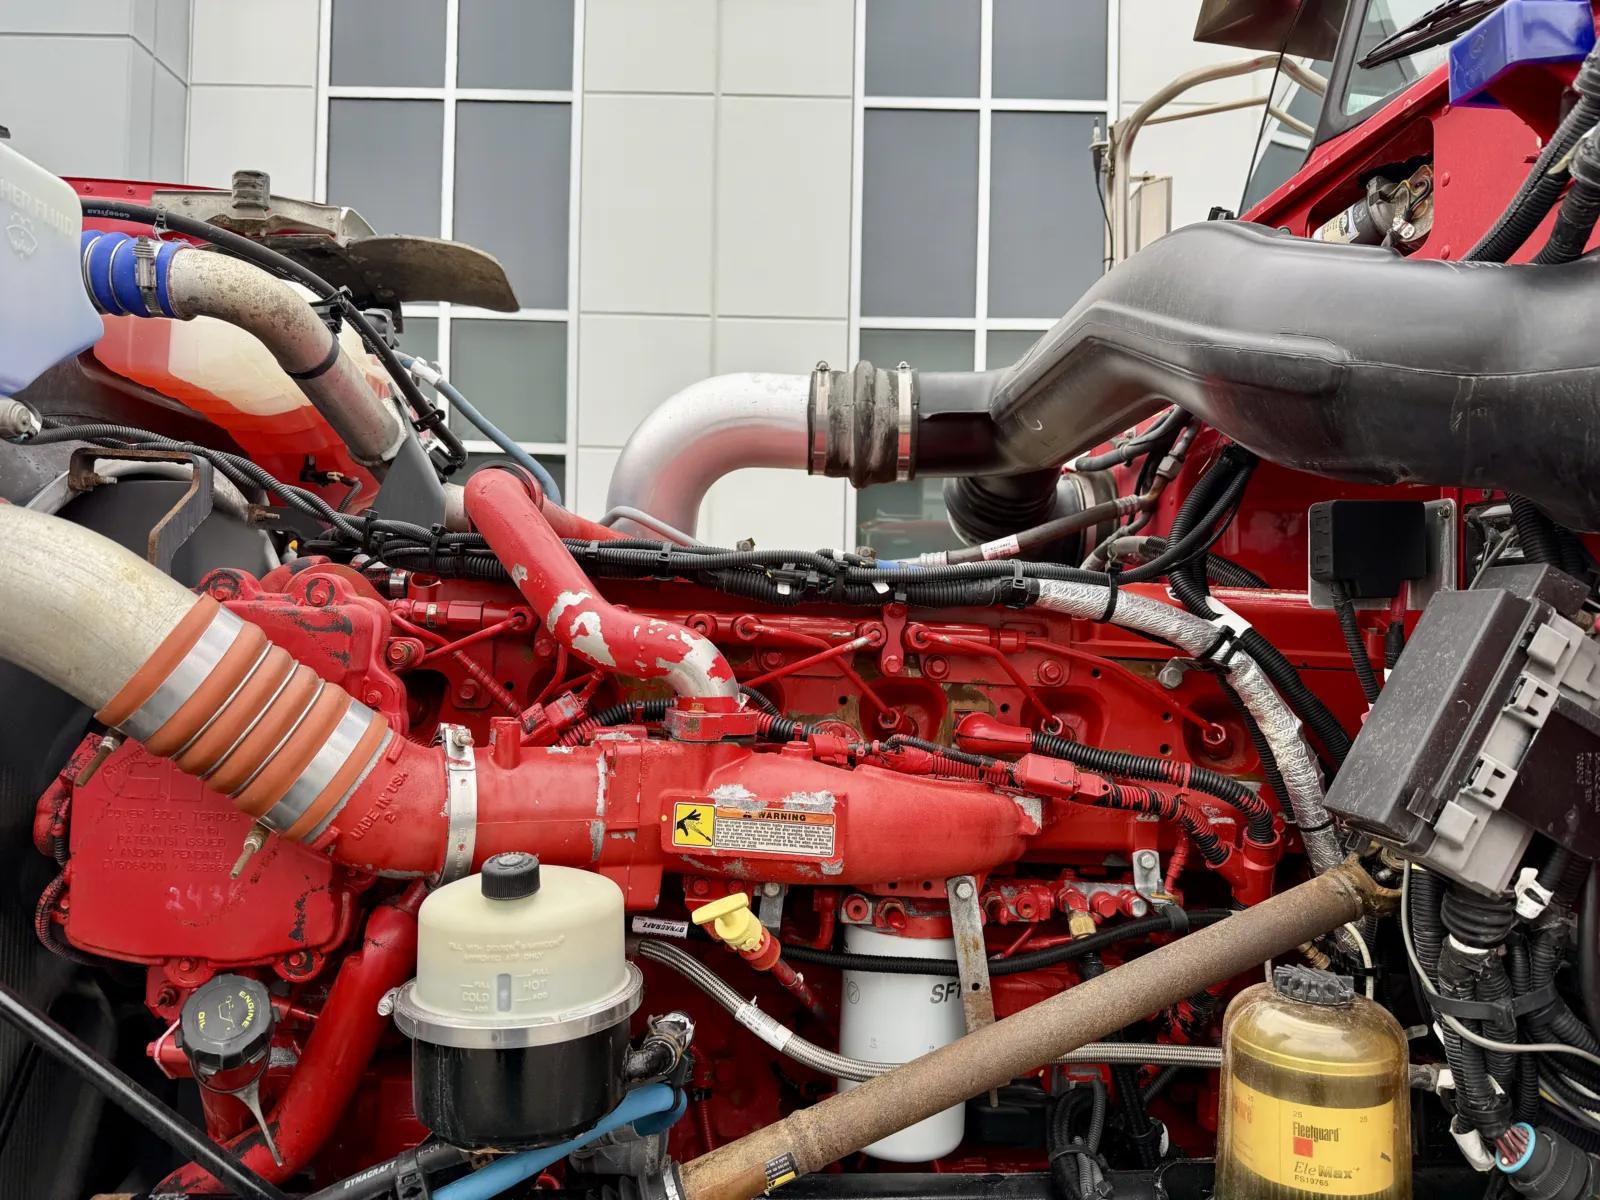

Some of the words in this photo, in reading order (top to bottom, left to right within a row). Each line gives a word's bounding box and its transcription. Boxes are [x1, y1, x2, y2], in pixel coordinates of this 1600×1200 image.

[34, 197, 73, 237] FLUID
[87, 208, 130, 218] GOODYEAR
[349, 807, 380, 841] MADE
[375, 793, 393, 810] IN
[386, 771, 409, 794] USA
[758, 811, 806, 822] WARNING
[642, 921, 685, 934] DYNACRAFT
[462, 990, 489, 1002] COLD
[238, 990, 255, 1028] ENGINE
[198, 1011, 207, 1033] OIL
[1292, 1121, 1340, 1142] Fleetguard
[344, 1161, 397, 1189] DYNACRAFT
[1294, 1174, 1329, 1187] FS19765
